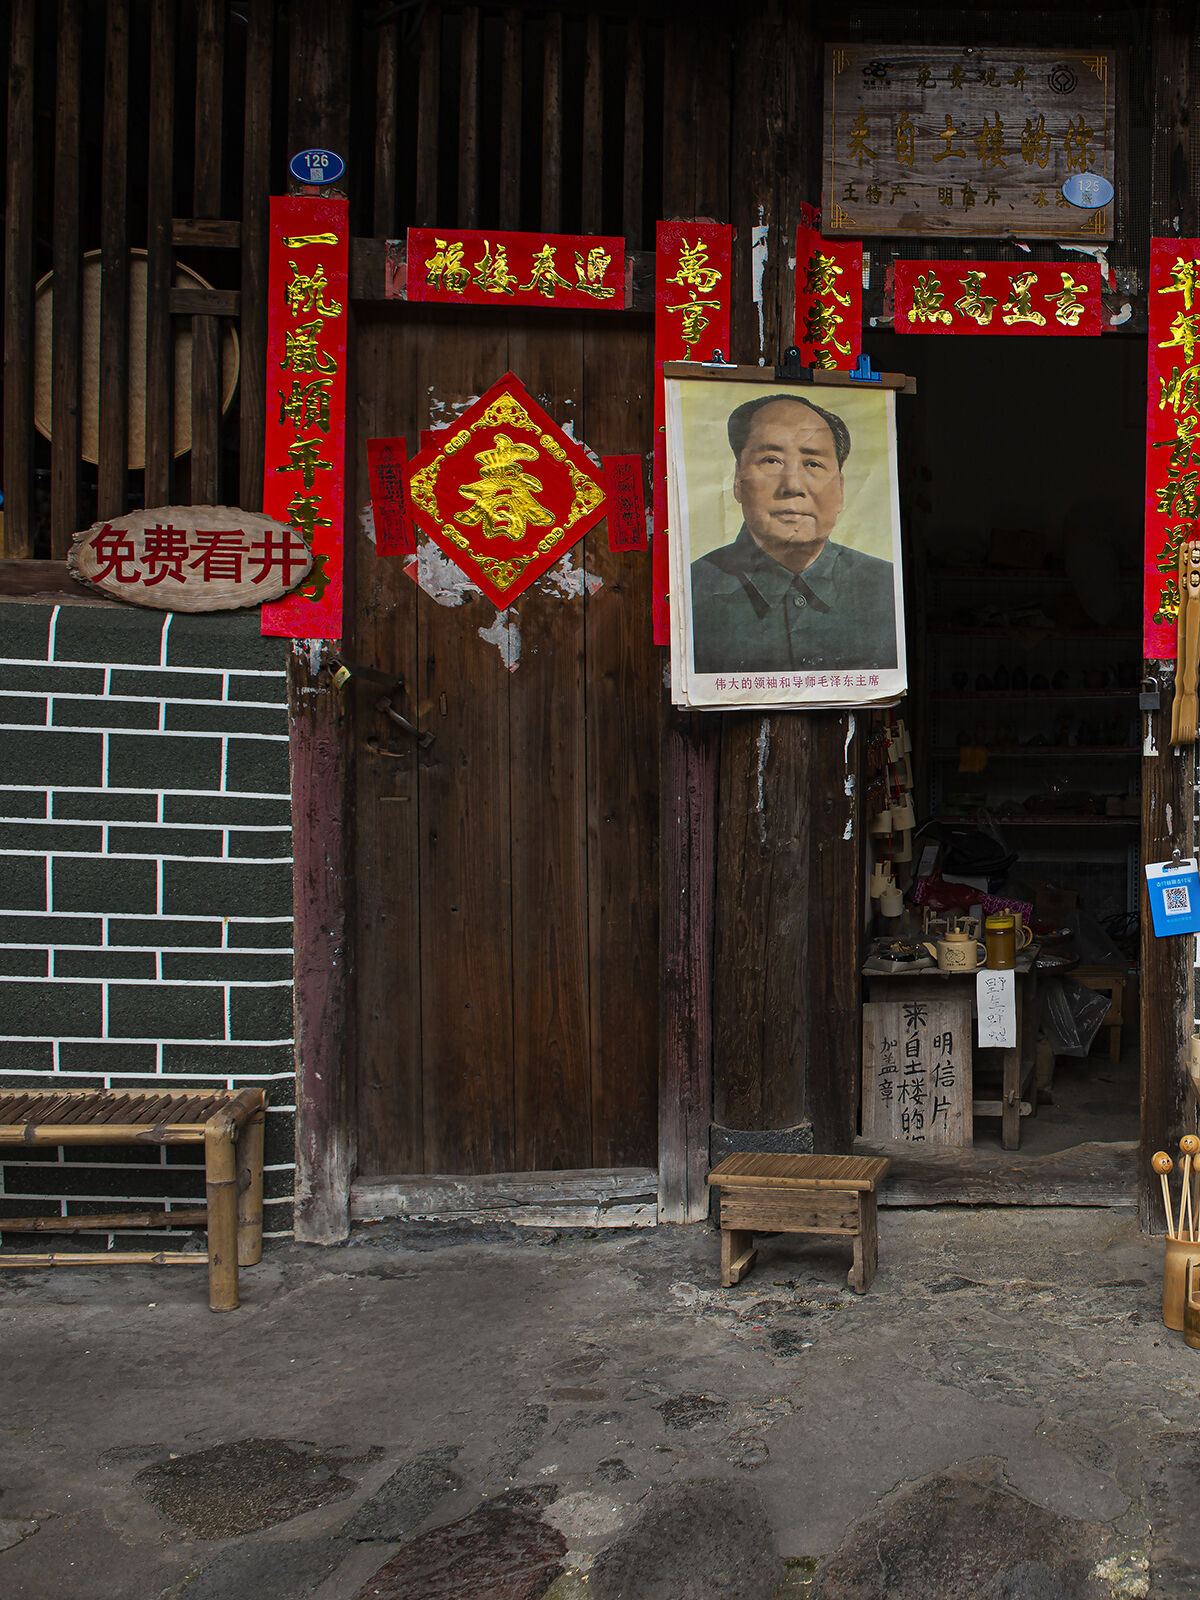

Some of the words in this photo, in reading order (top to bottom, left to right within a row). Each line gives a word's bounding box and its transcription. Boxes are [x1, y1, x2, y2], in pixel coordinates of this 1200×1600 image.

[916, 63, 1030, 91] 免费观井
[304, 154, 329, 167] 126
[1078, 180, 1100, 192] 125
[453, 432, 556, 541] 春
[89, 523, 307, 587] 免费看井
[714, 674, 880, 691] 伟大的领袖和导师毛泽东主席
[878, 1036, 899, 1109] 加盖章
[930, 1031, 956, 1131] 明信片
